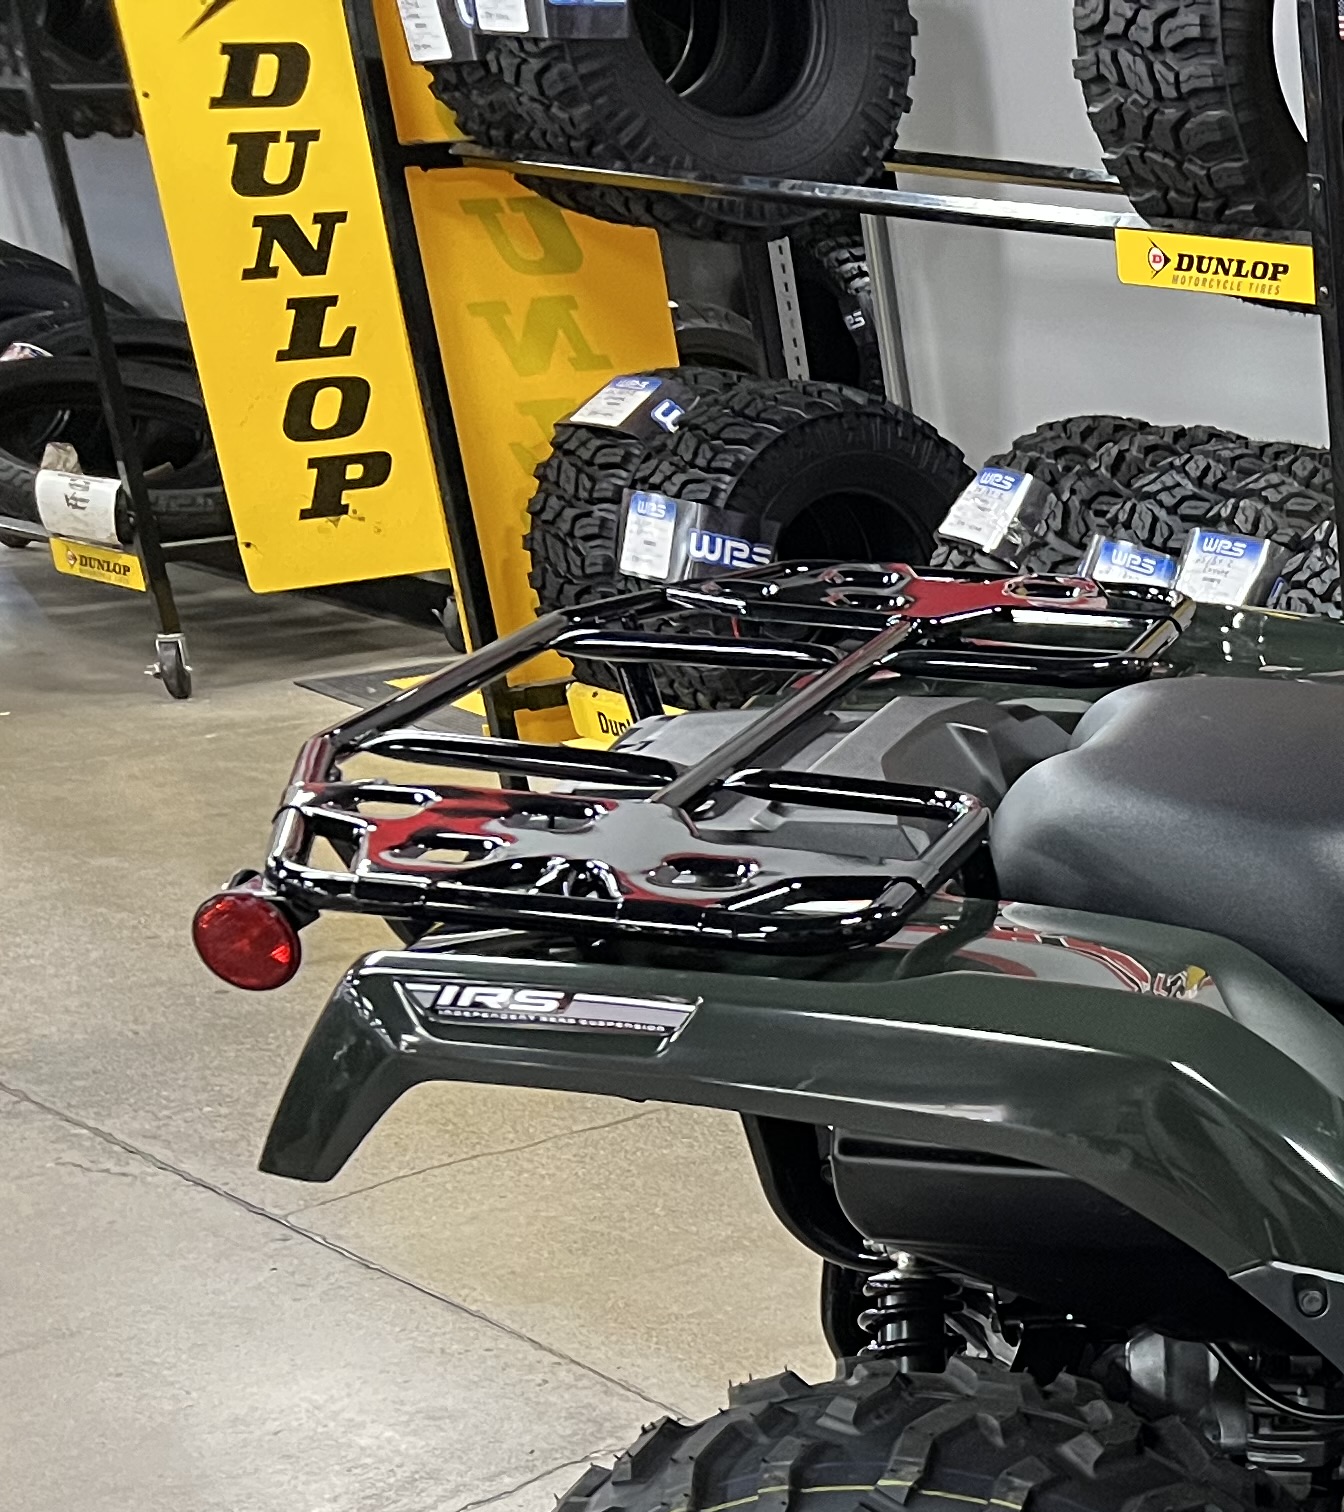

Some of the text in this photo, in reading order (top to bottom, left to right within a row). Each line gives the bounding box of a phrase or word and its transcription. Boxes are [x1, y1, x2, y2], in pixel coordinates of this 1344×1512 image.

[1174, 253, 1289, 282] DUNLOP
[209, 41, 392, 521] DUNLOP
[1171, 273, 1281, 296] MOTORCYCLE TIRES
[978, 470, 1017, 491] WPS
[636, 500, 668, 519] WPS
[689, 528, 773, 569] WPS
[1202, 536, 1248, 558] WPS
[79, 554, 131, 576] DUNLOP
[1110, 548, 1158, 576] WPS
[436, 984, 565, 1013] IRS
